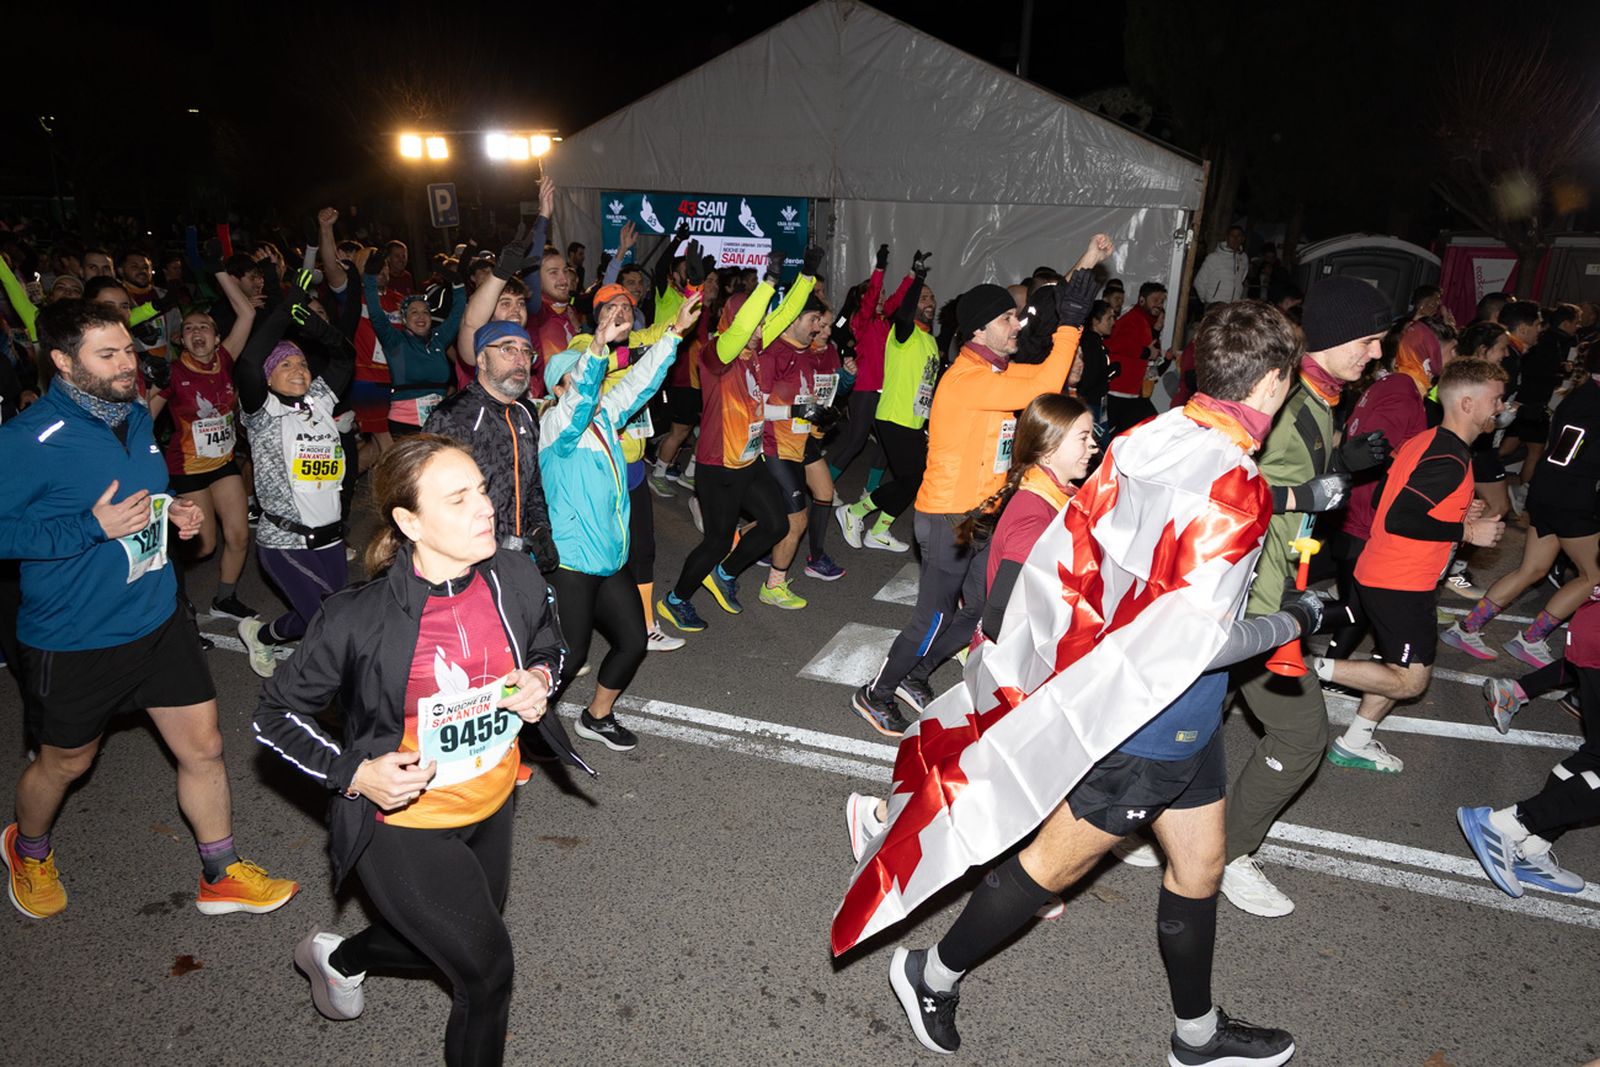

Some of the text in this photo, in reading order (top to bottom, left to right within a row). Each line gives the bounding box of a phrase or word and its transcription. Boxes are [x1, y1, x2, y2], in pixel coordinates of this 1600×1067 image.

[435, 189, 452, 213] P
[678, 200, 728, 217] 43 SAN
[721, 252, 745, 264] SAN
[205, 428, 231, 445] 7445
[301, 460, 339, 476] 5956
[446, 693, 493, 715] NOCHE DE
[432, 716, 453, 729] SAN
[440, 710, 509, 753] 9455
